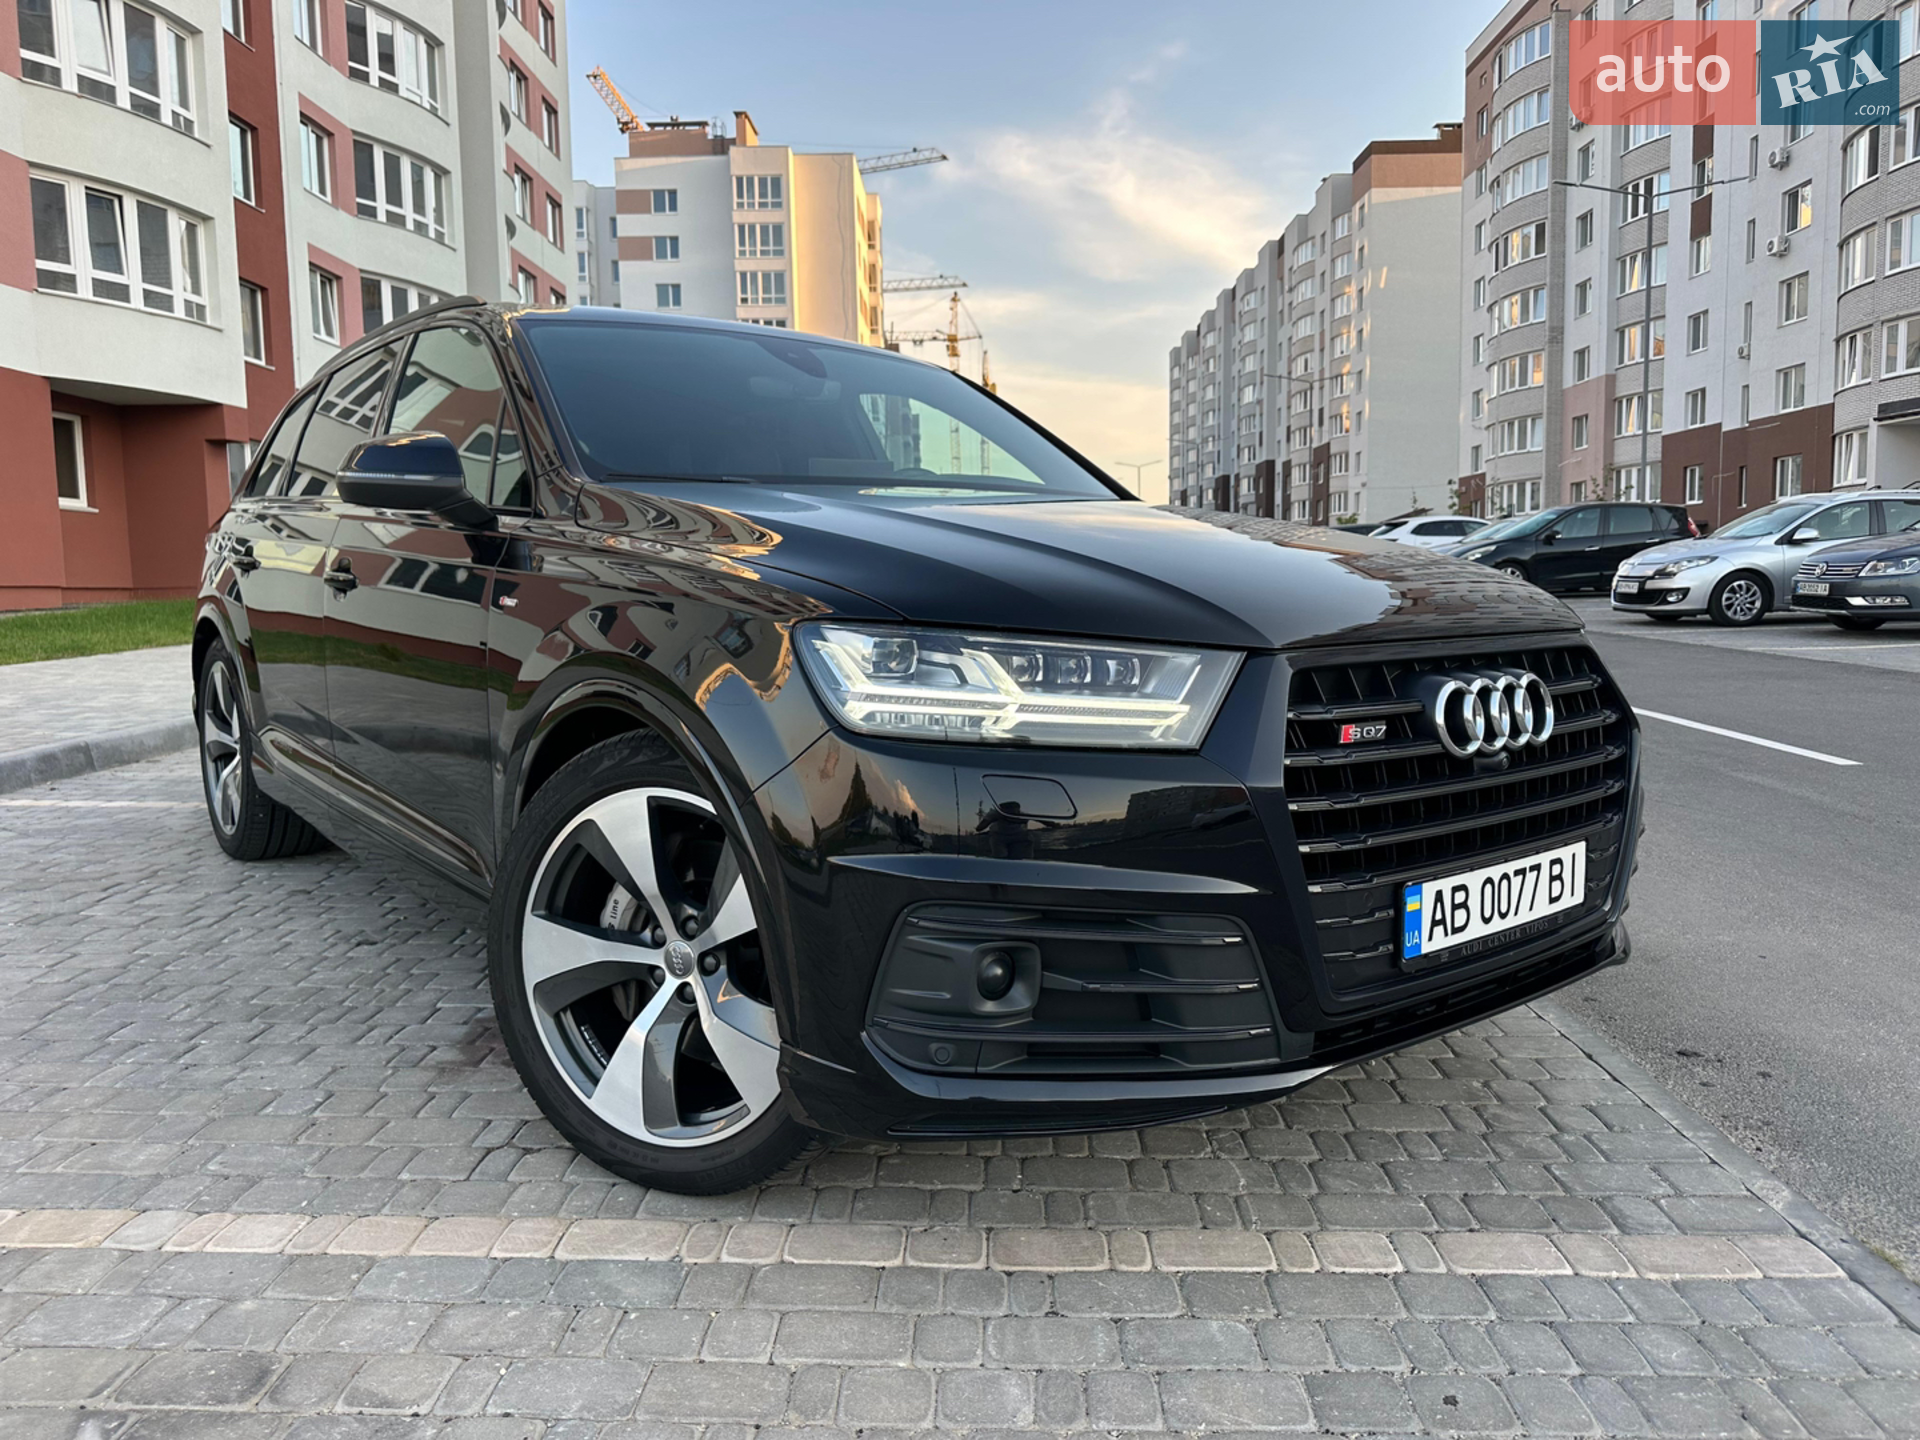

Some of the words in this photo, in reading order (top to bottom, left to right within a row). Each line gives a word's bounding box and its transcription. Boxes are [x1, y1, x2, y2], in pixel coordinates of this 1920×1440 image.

[1348, 725, 1387, 740] SQ7
[1427, 883, 1471, 942] AB
[1480, 862, 1542, 925] 0077
[1548, 852, 1576, 906] BI
[609, 898, 620, 920] line
[1404, 929, 1420, 947] UA
[1461, 939, 1483, 956] AUDI
[1487, 928, 1522, 948] CENTER
